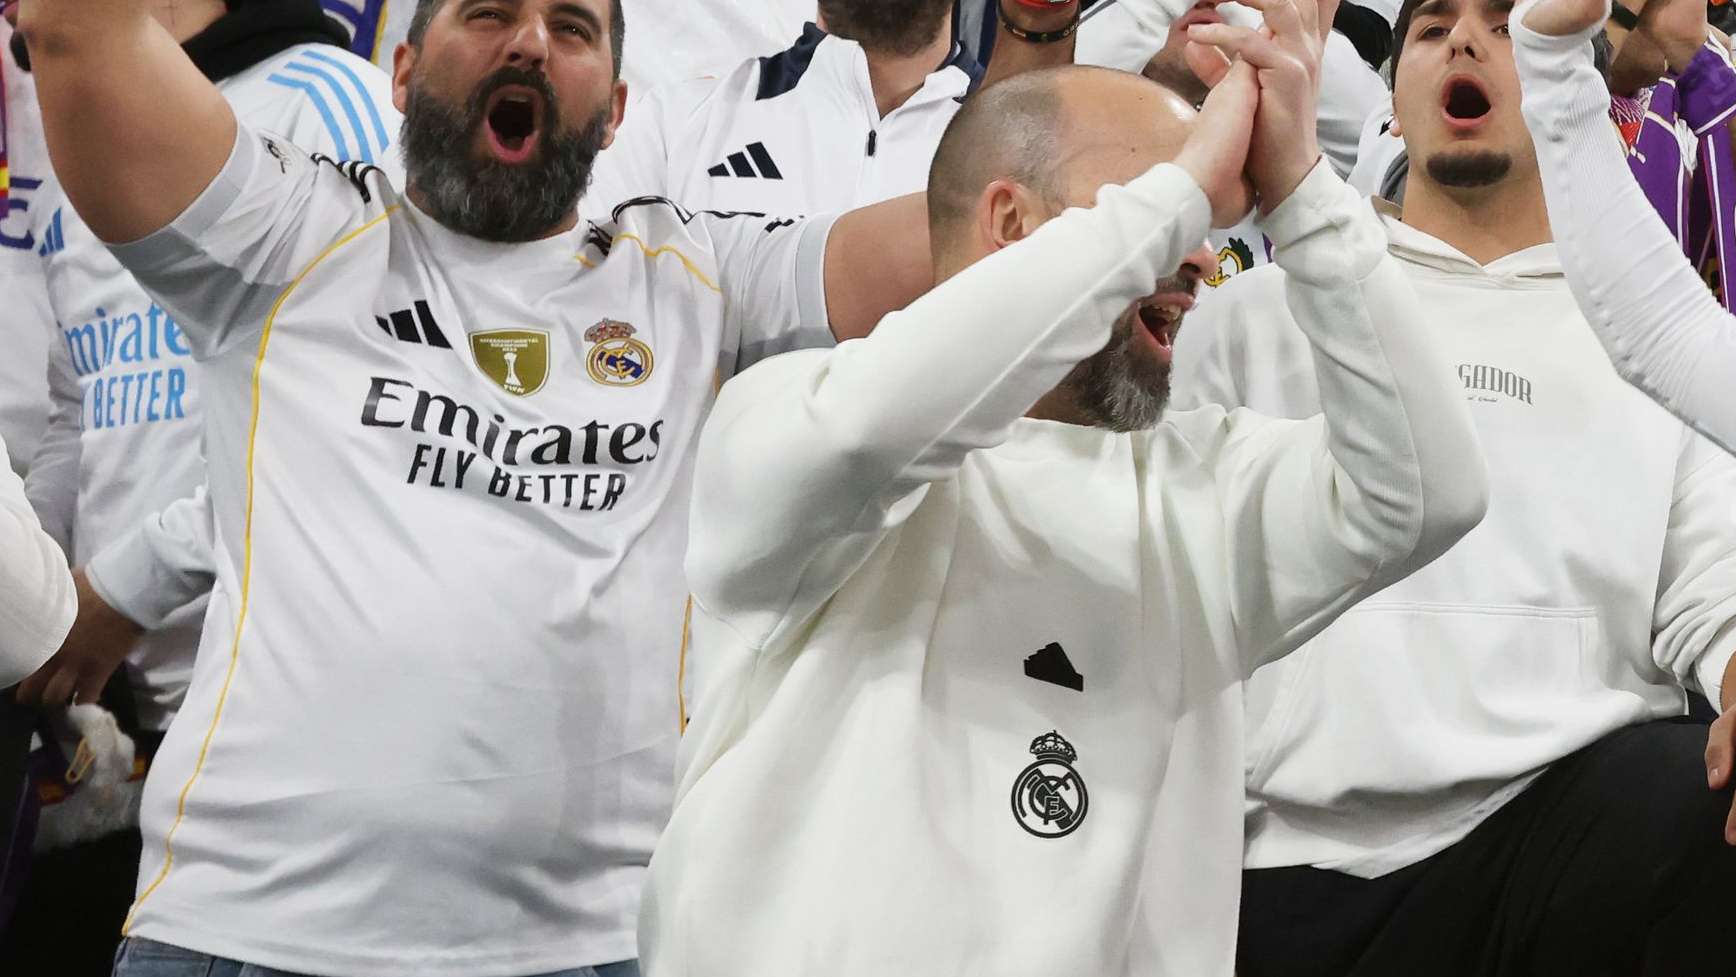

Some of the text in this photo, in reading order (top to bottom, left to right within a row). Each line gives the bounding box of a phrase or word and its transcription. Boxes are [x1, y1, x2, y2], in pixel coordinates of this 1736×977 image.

[64, 302, 191, 377] mirate
[94, 367, 186, 430] BETTER
[360, 376, 664, 467] Emirates
[407, 443, 628, 512] FLY BETTER
